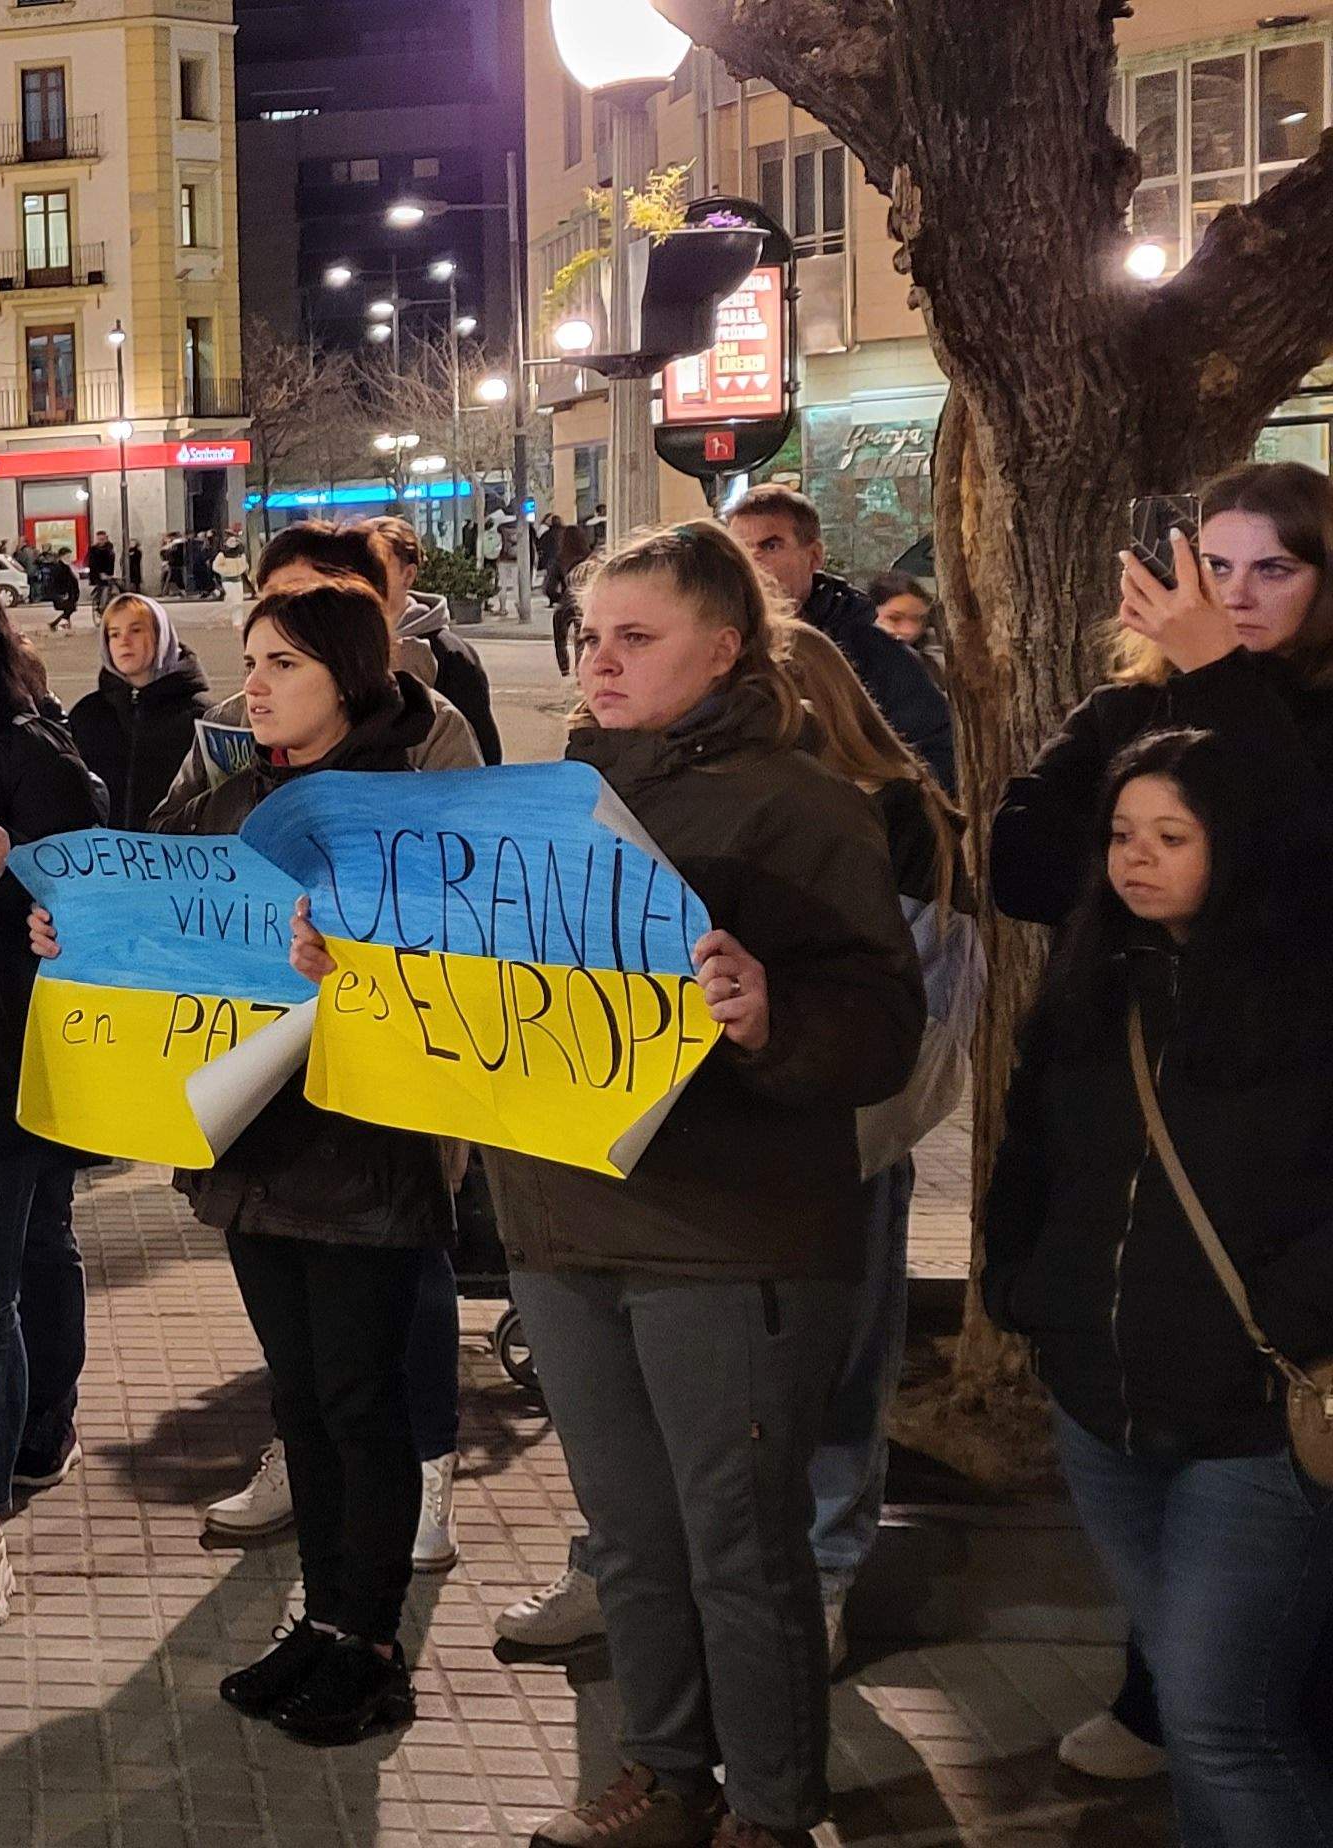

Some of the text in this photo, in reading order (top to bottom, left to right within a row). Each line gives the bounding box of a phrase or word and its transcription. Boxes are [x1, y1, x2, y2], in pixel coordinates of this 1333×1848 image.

[189, 446, 235, 462] Santander
[34, 837, 237, 883] QUEREMOS
[335, 970, 389, 1021] es
[62, 1009, 117, 1044] en
